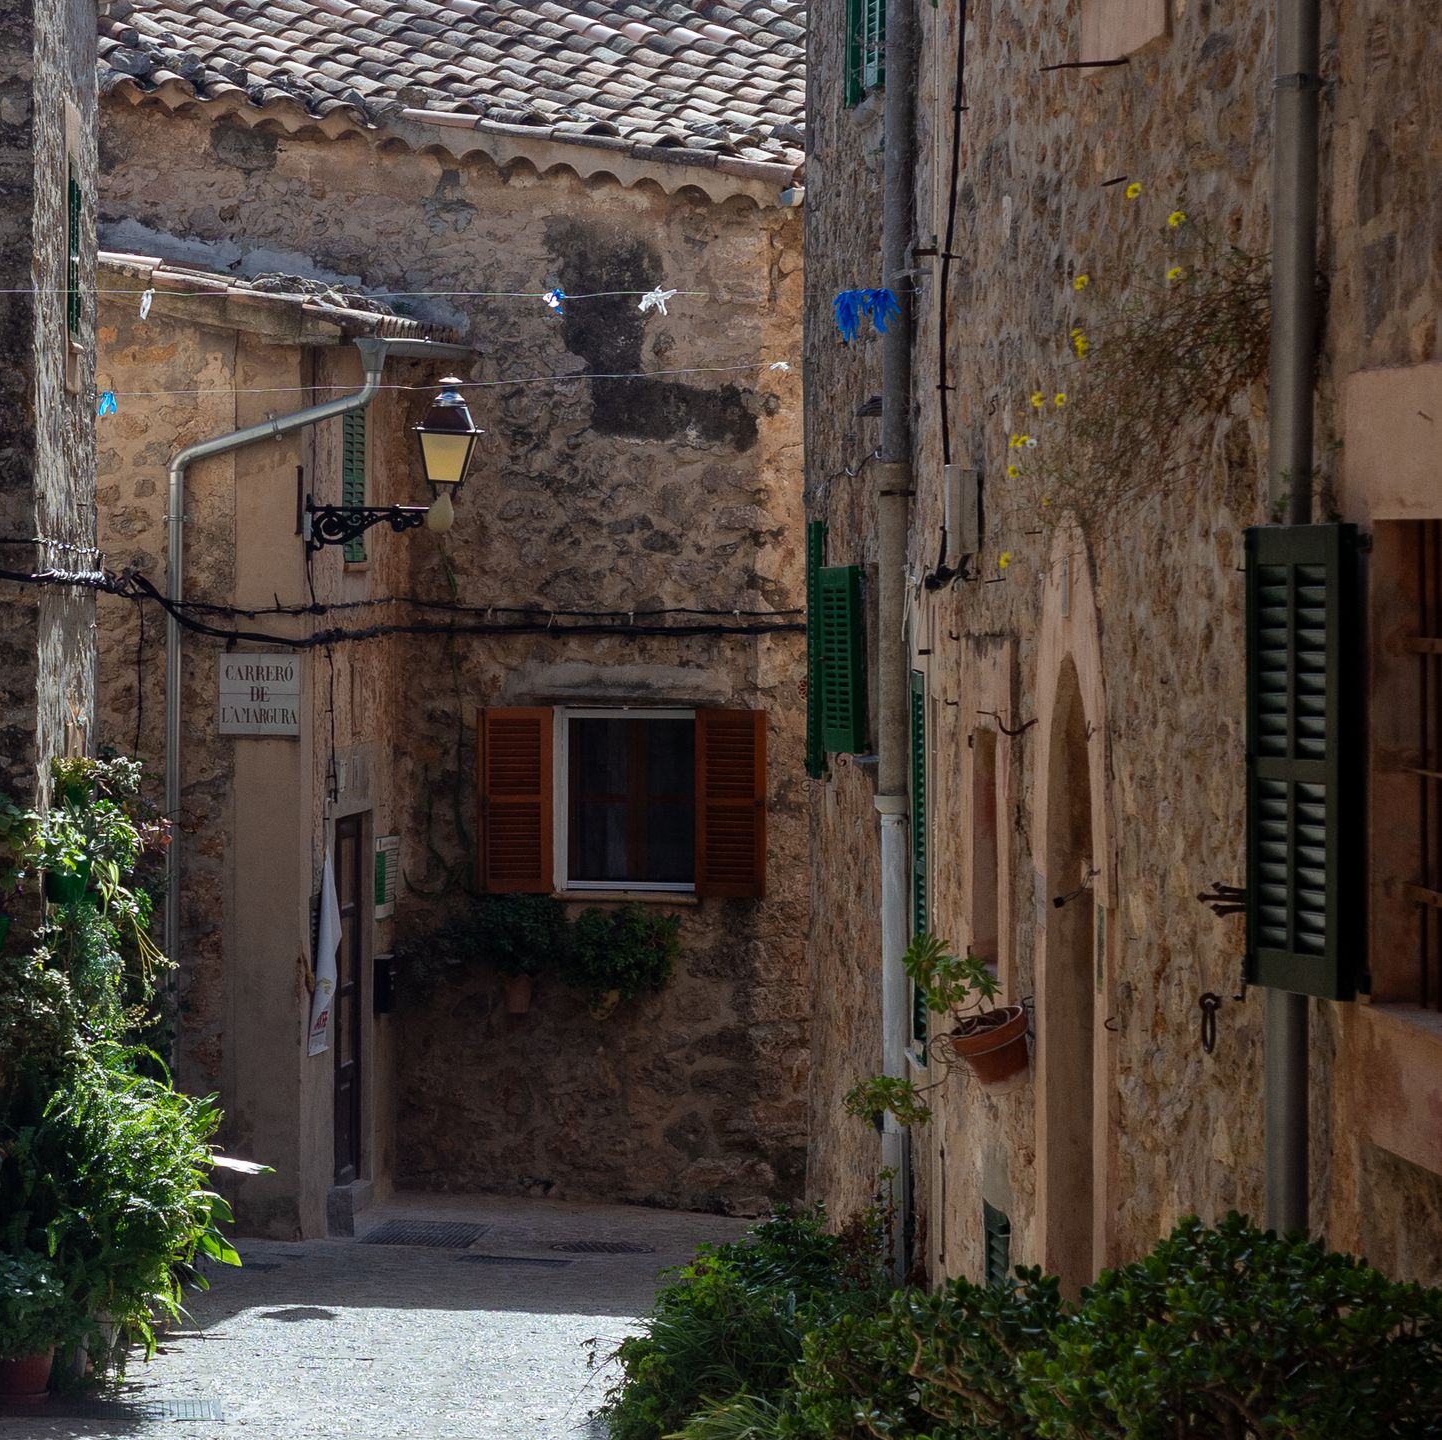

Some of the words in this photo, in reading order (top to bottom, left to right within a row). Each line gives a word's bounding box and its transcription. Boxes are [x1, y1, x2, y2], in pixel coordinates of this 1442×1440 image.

[225, 661, 294, 682] CARRERÓ
[249, 686, 271, 703] DE
[221, 706, 298, 725] L'AMARGURA
